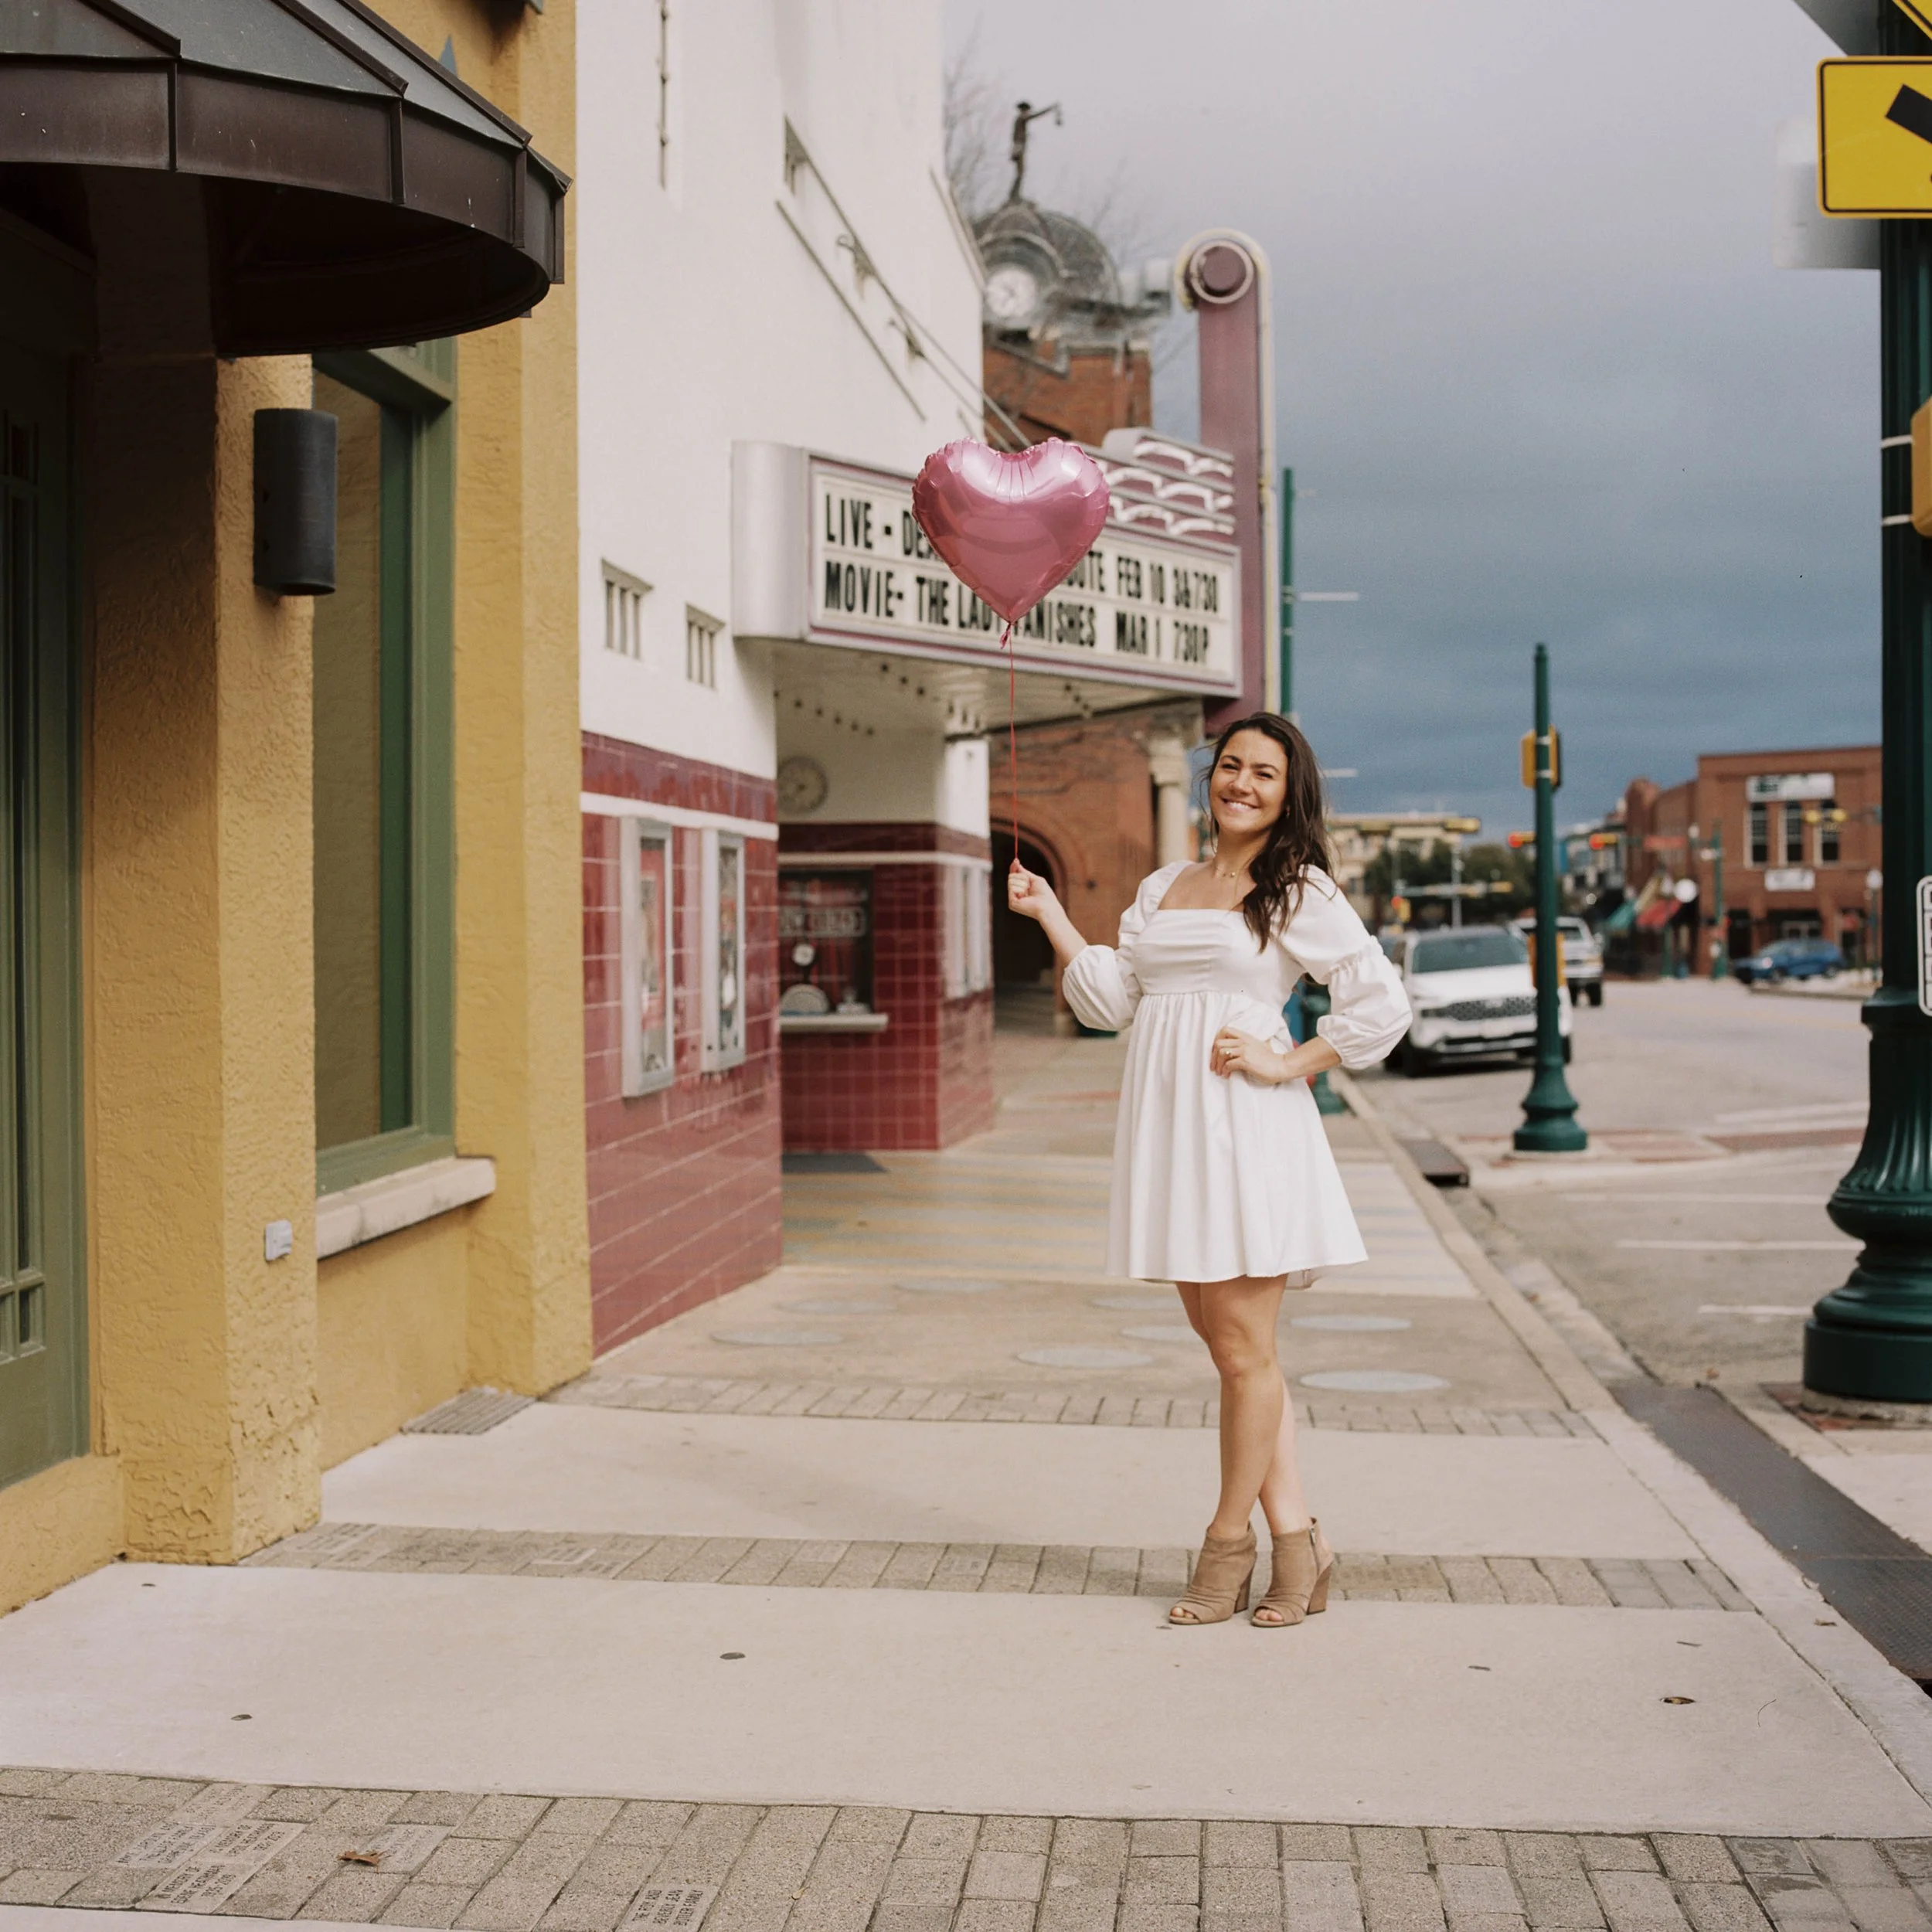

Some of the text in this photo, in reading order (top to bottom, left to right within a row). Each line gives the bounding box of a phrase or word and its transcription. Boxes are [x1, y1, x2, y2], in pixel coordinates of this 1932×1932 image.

[826, 495, 872, 549] LIVE
[1117, 556, 1142, 600] FEB
[916, 576, 948, 625] THE
[1116, 611, 1148, 655] MAR
